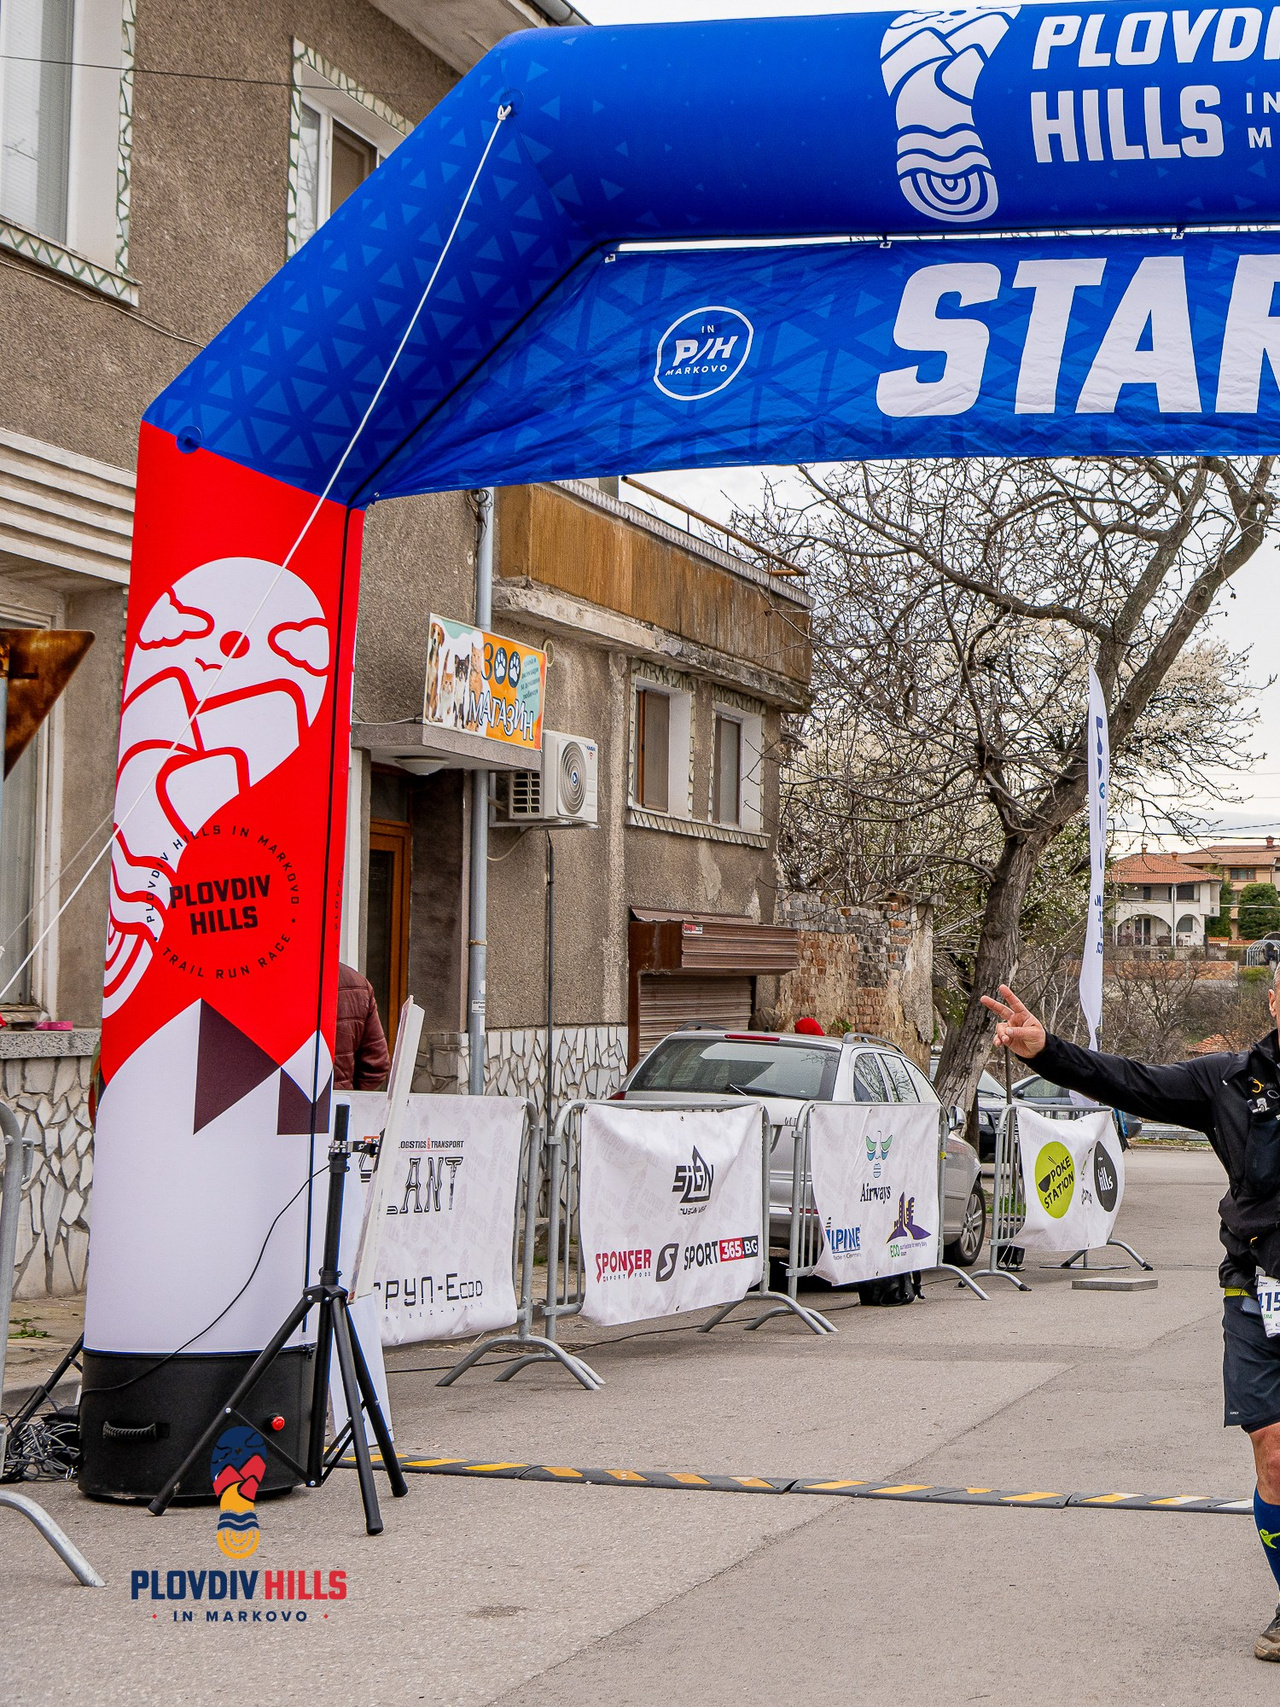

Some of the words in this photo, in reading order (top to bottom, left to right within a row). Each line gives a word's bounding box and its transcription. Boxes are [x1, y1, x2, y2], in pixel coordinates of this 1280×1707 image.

[1031, 85, 1224, 163] HILLS
[701, 325, 715, 333] IN
[672, 336, 739, 367] P/H
[665, 364, 728, 376] MARKOVO
[468, 691, 534, 741] МАГАЗИН
[146, 852, 170, 923] PLOVDIV
[172, 825, 221, 850] HILLS
[231, 825, 250, 838] IN
[257, 835, 300, 905] MARKOVO
[169, 874, 271, 909] PLOVDIV
[190, 906, 258, 936] HILLS
[162, 947, 204, 978] TRAIL
[216, 966, 250, 979] RUN
[258, 935, 291, 968] RACE
[431, 1140, 465, 1149] TRANSPORT
[1050, 1155, 1071, 1182] POKE
[861, 1182, 891, 1204] Airways
[1043, 1171, 1074, 1209] STATION
[594, 1249, 652, 1284] SPONSER
